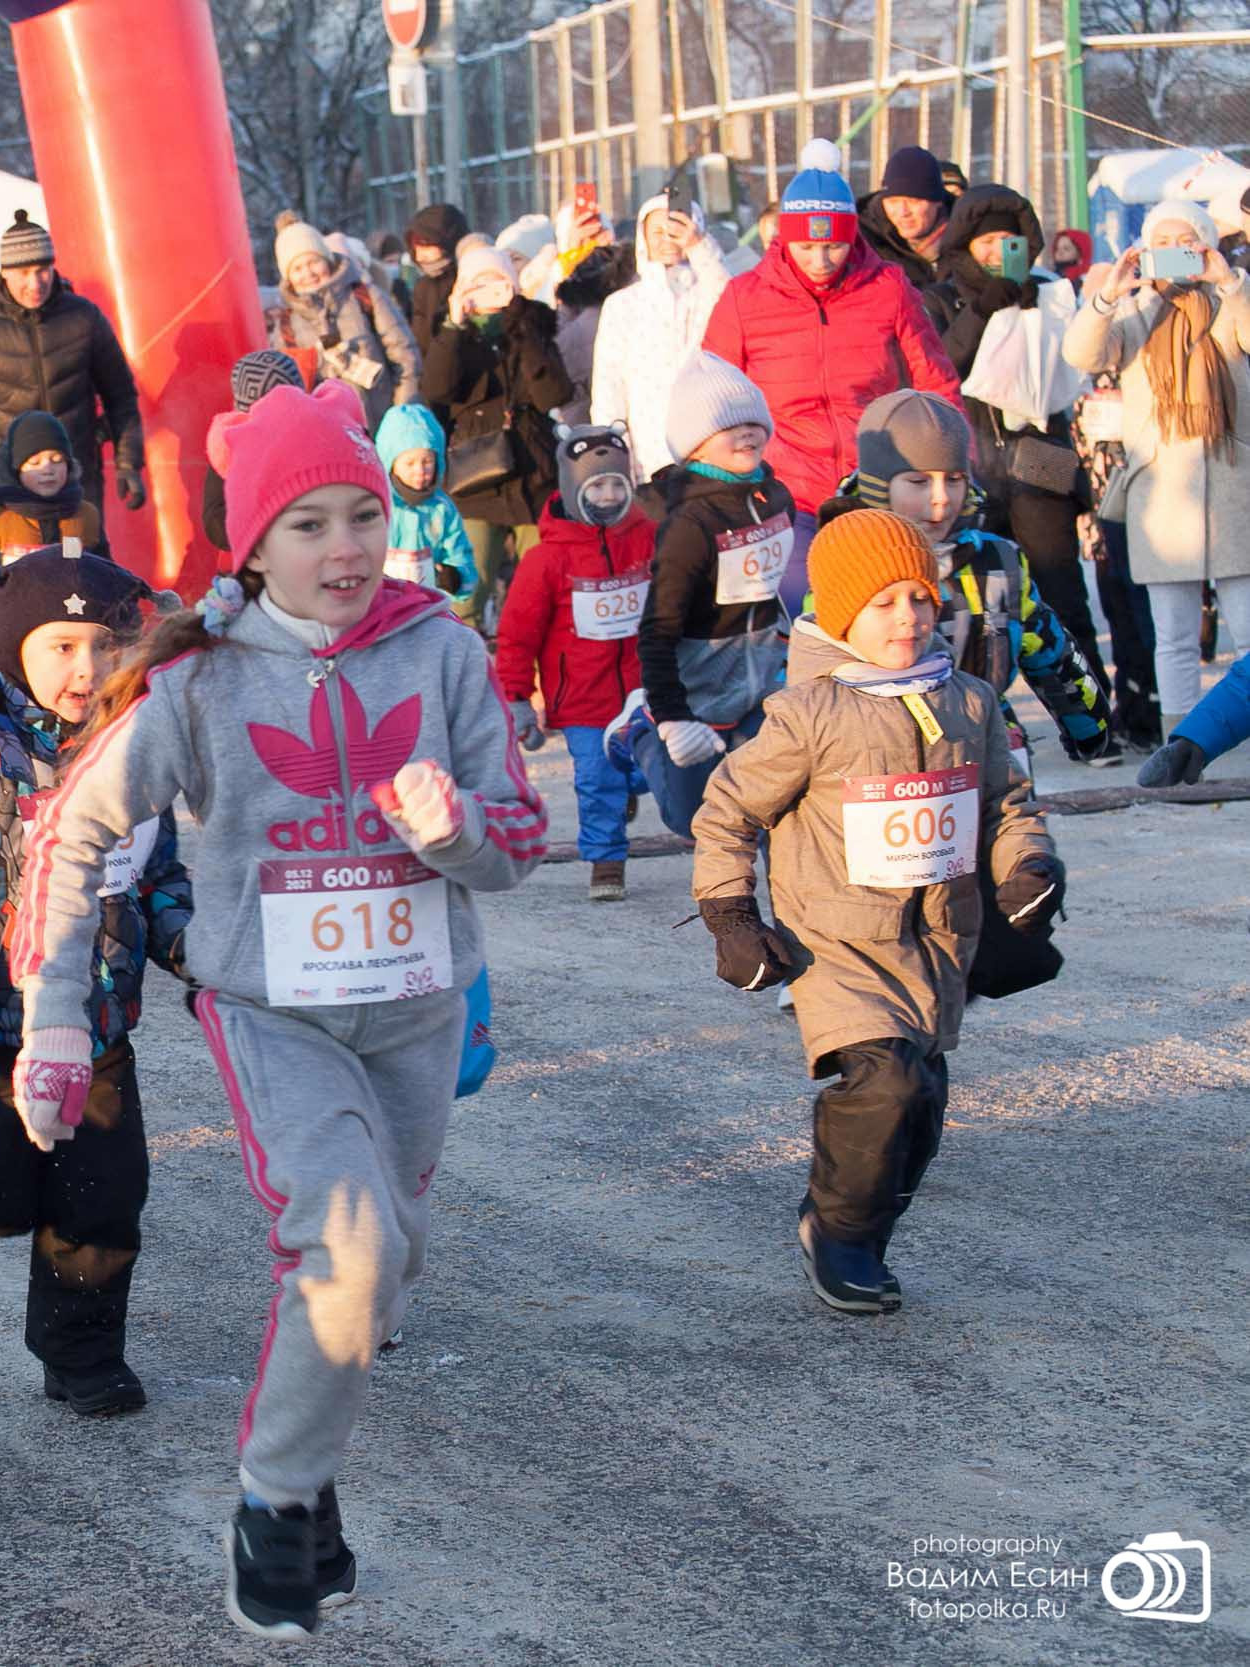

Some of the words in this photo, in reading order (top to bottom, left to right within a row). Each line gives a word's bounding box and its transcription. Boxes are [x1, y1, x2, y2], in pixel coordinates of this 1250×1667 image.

[743, 541, 782, 576] 629
[595, 592, 639, 618] 628
[893, 781, 929, 798] 600
[932, 782, 943, 793] М
[884, 803, 956, 848] 606
[322, 867, 370, 888] 600
[376, 869, 394, 885] М
[311, 898, 414, 952] 618
[302, 960, 364, 972] ЯРОСЛАВА
